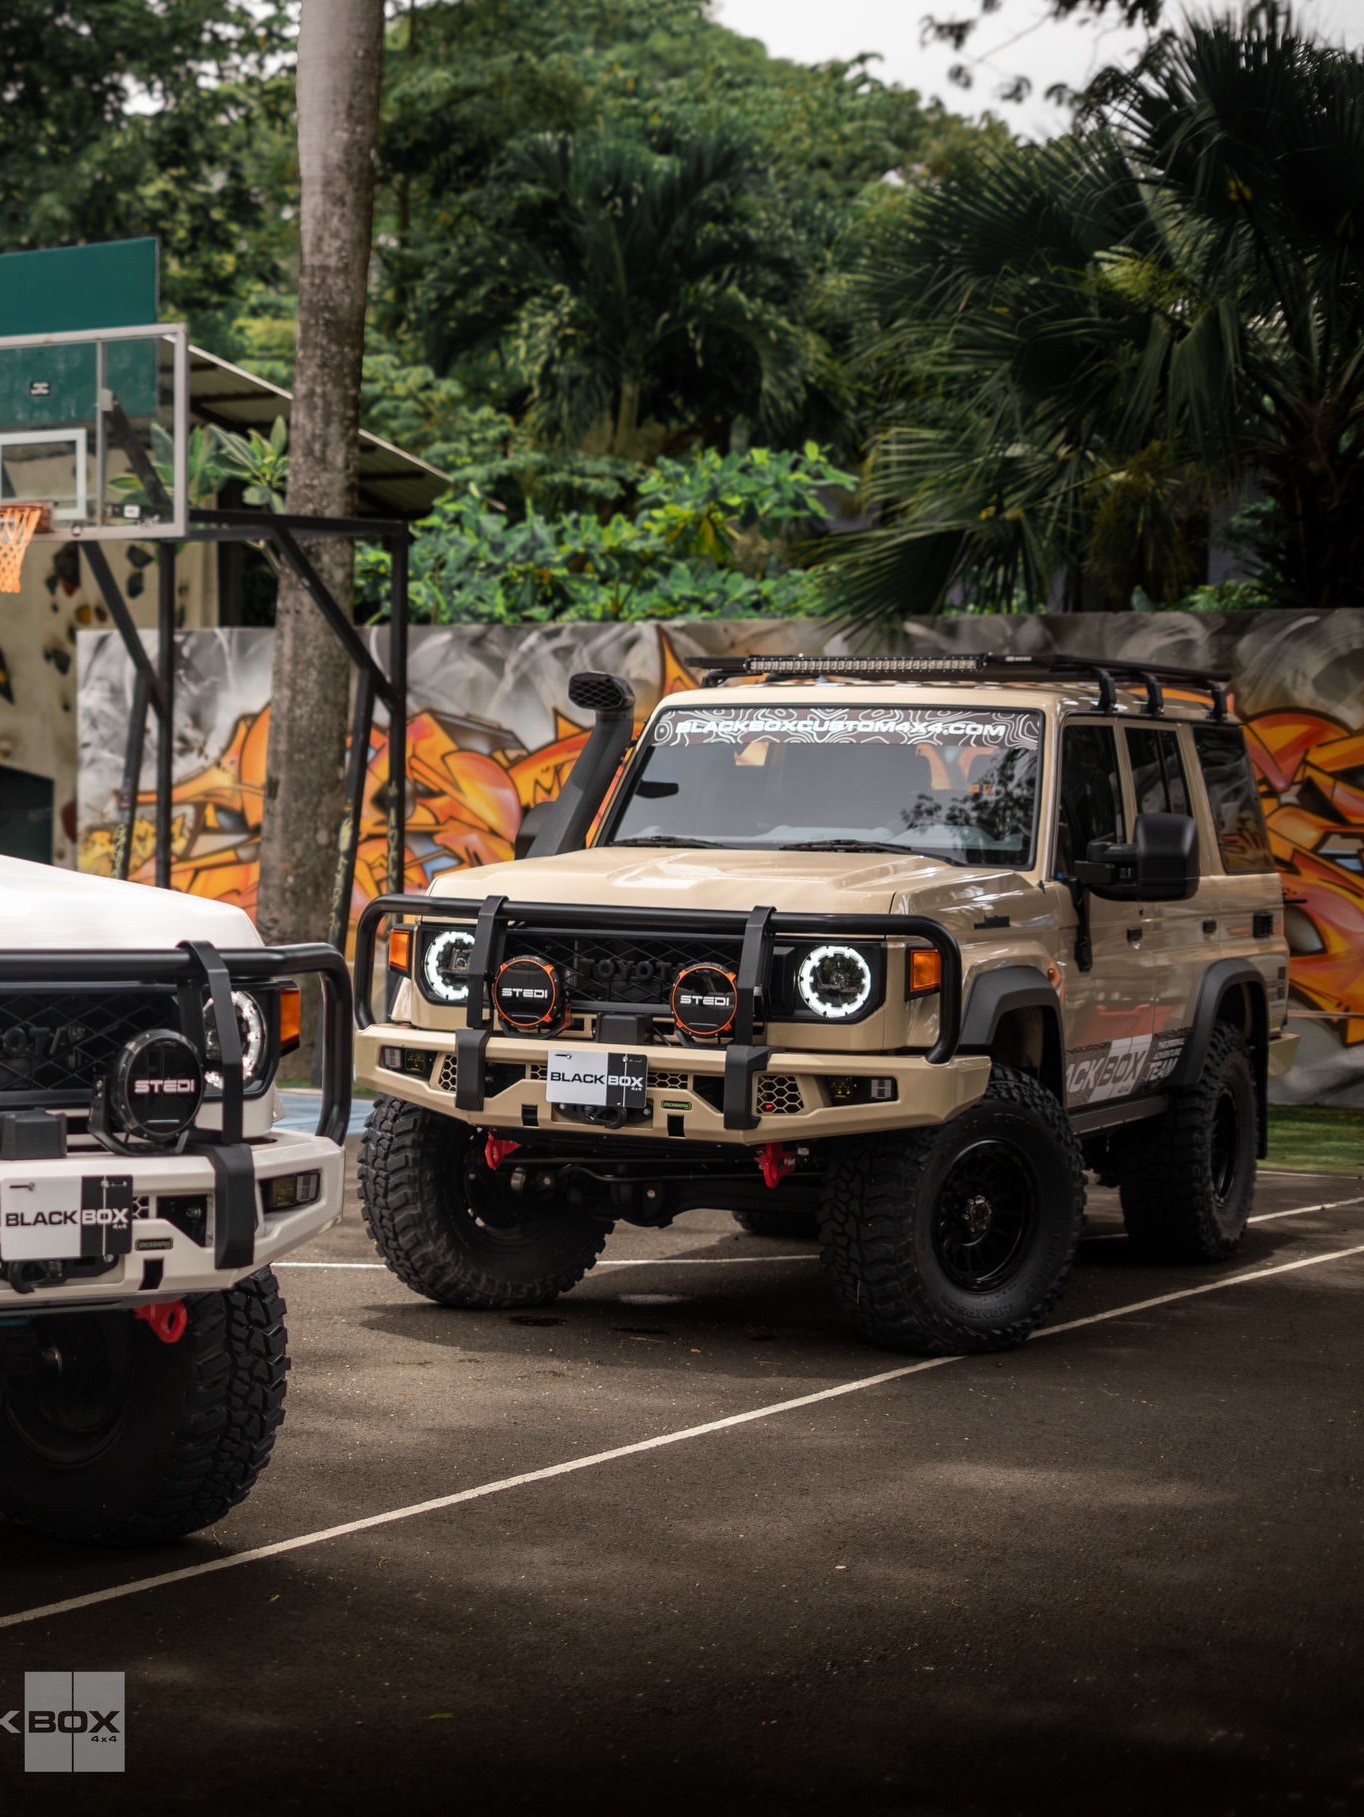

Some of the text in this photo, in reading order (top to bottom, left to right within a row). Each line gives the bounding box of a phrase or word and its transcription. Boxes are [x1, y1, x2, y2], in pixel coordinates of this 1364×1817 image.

[501, 987, 548, 998] STEDI
[680, 994, 730, 1007] STEDI
[1096, 1050, 1147, 1088] BOX
[1145, 1057, 1179, 1082] TEAM
[134, 1079, 196, 1094] STEDI
[550, 1071, 644, 1088] BLACK BOX
[5, 1208, 129, 1227] BLACK BOX
